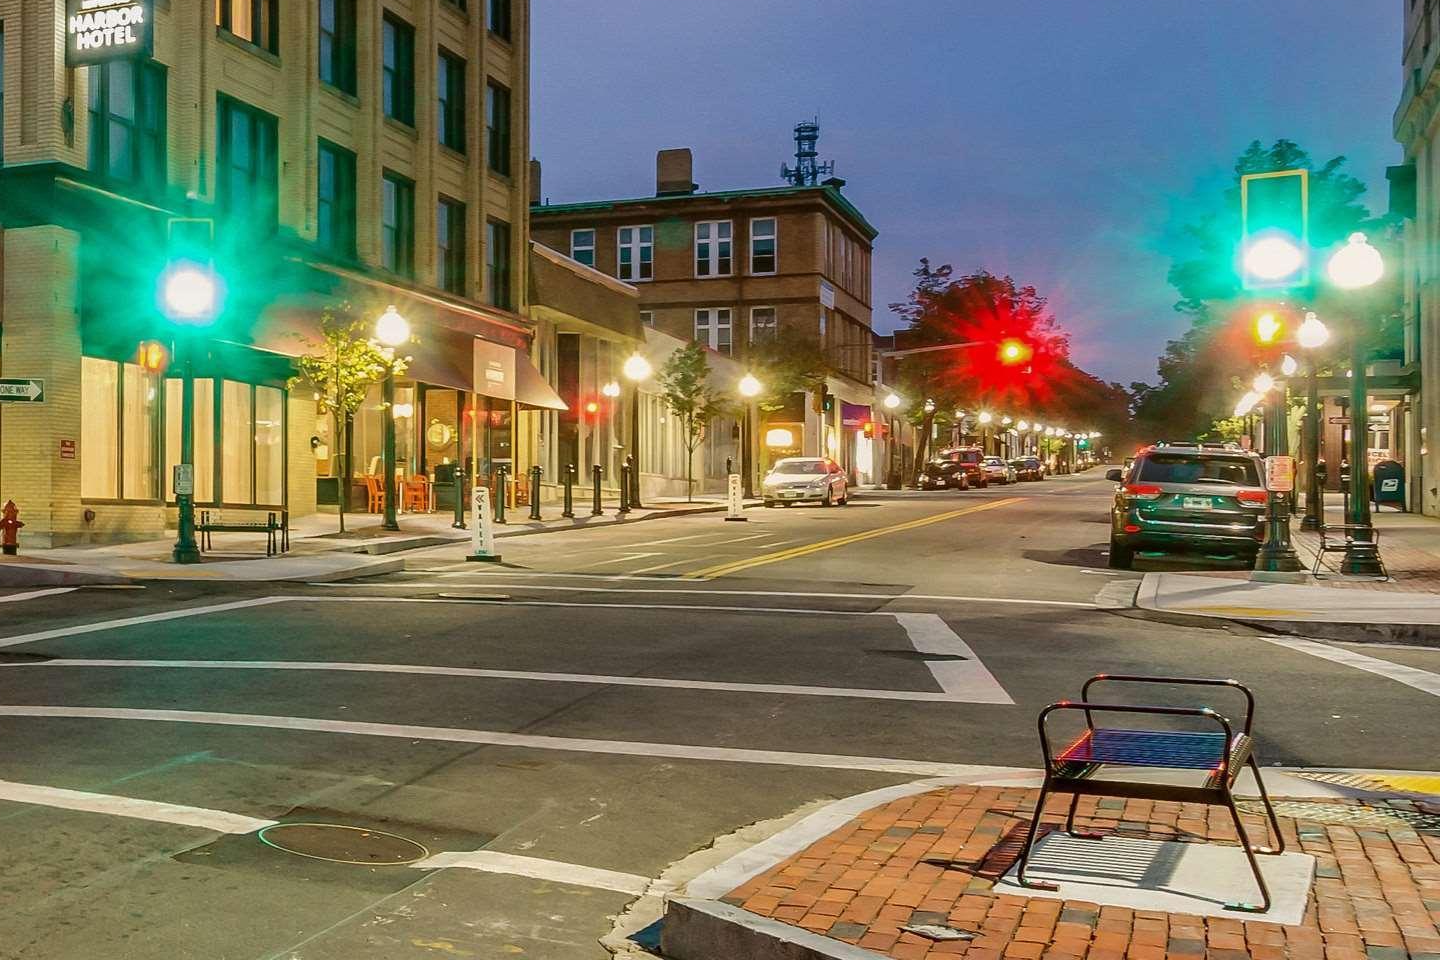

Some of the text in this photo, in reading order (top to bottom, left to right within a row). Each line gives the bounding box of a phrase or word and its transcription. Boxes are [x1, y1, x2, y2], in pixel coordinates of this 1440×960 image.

[69, 5, 144, 34] HARBOR
[76, 25, 137, 50] HOTEL
[0, 385, 29, 394] ONE WAY
